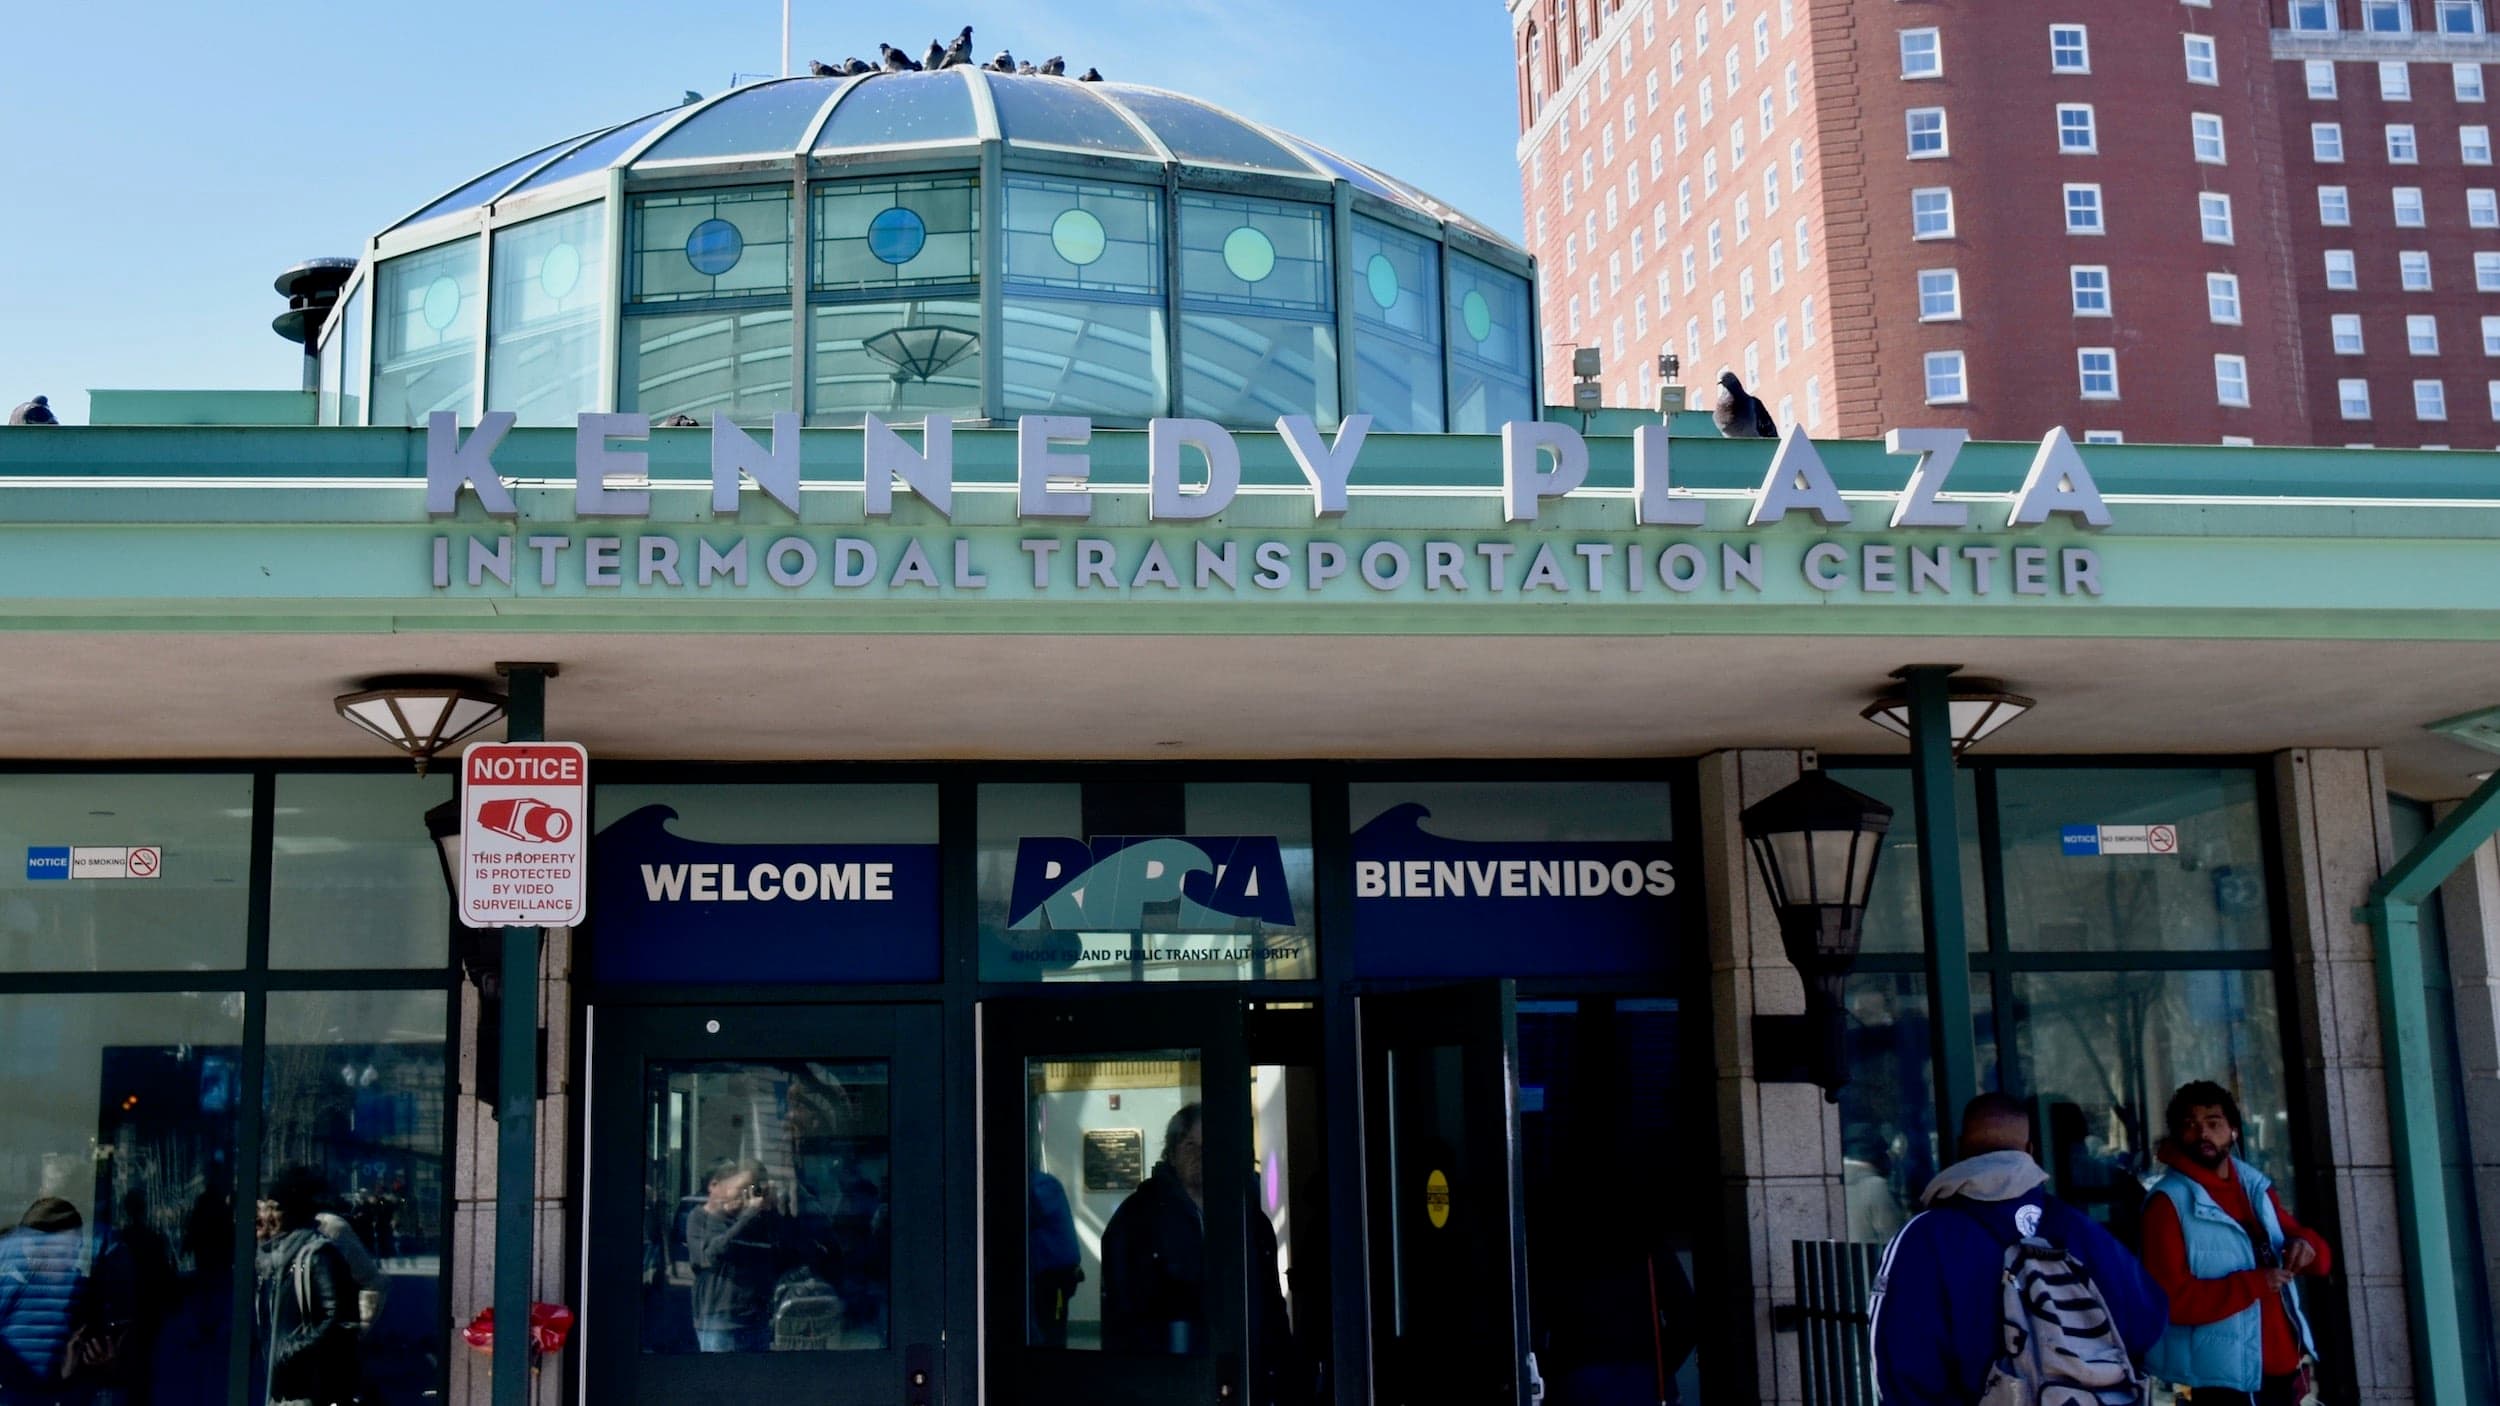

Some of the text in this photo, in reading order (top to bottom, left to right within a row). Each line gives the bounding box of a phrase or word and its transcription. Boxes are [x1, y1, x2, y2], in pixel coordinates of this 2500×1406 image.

[426, 411, 2113, 529] KENNEDY PLAZA
[432, 535, 2103, 595] INTERMODAL TRANSPORTATION CENTER
[474, 757, 577, 780] NOTICE
[29, 857, 68, 867] NOTICE
[472, 853, 575, 863] THIS PROPERTY
[476, 868, 571, 879] IS PROTECTED
[1355, 860, 1676, 897] BIENVENIDOS
[640, 862, 894, 901] WELCOME
[492, 884, 554, 894] BY VIDEO
[472, 899, 573, 910] SURVEILLANCE
[1166, 948, 1220, 960] TRANSIT
